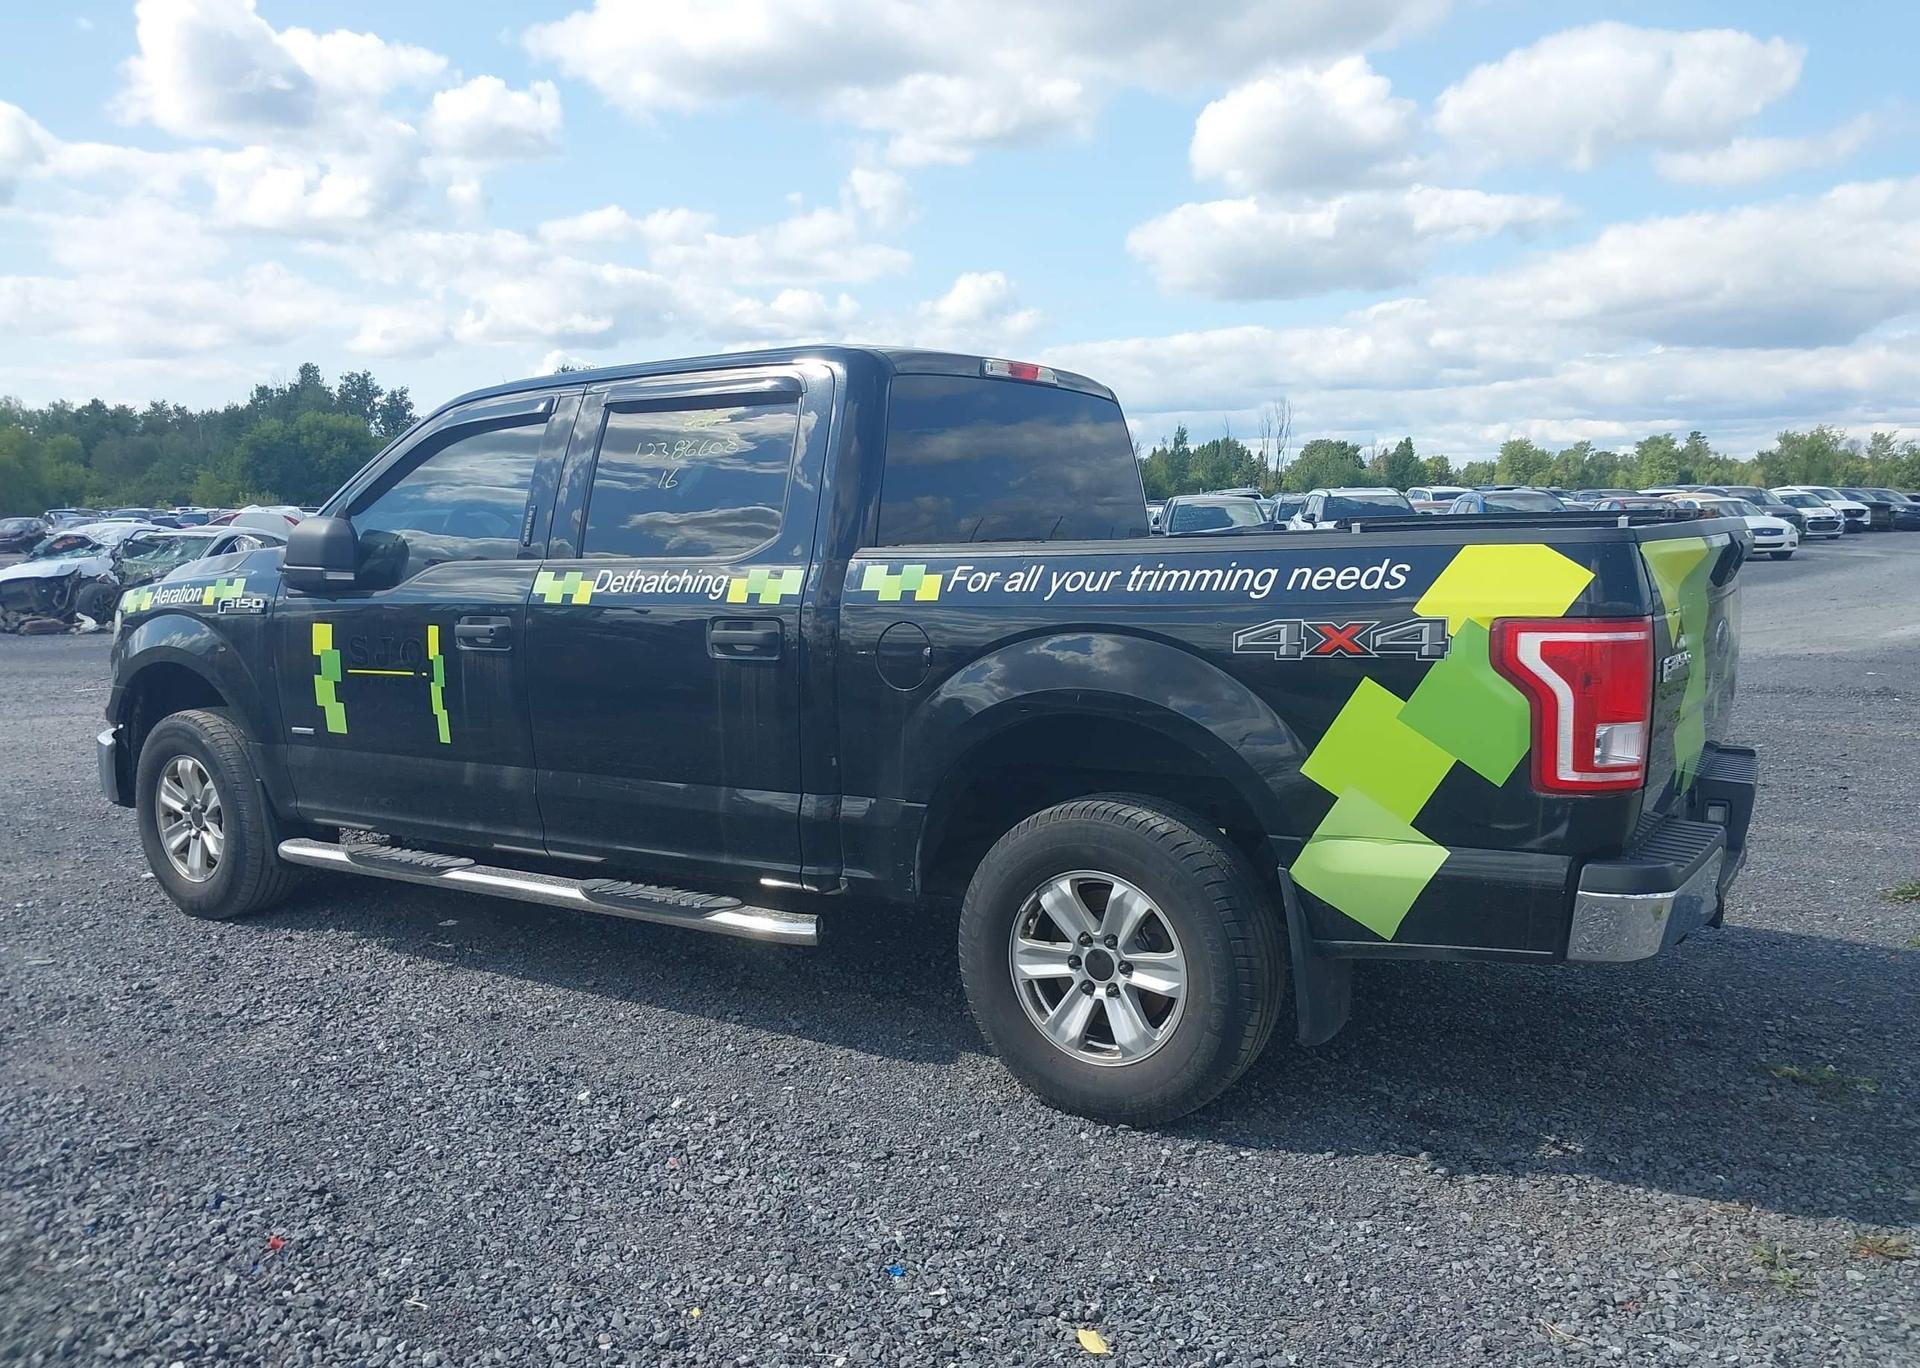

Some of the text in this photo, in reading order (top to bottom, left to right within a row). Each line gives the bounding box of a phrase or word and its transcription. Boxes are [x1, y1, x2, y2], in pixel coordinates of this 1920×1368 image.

[657, 466, 680, 489] 16
[592, 569, 729, 600] Dethatching
[947, 558, 1411, 601] For all your trimming needs
[151, 583, 202, 605] Aeration
